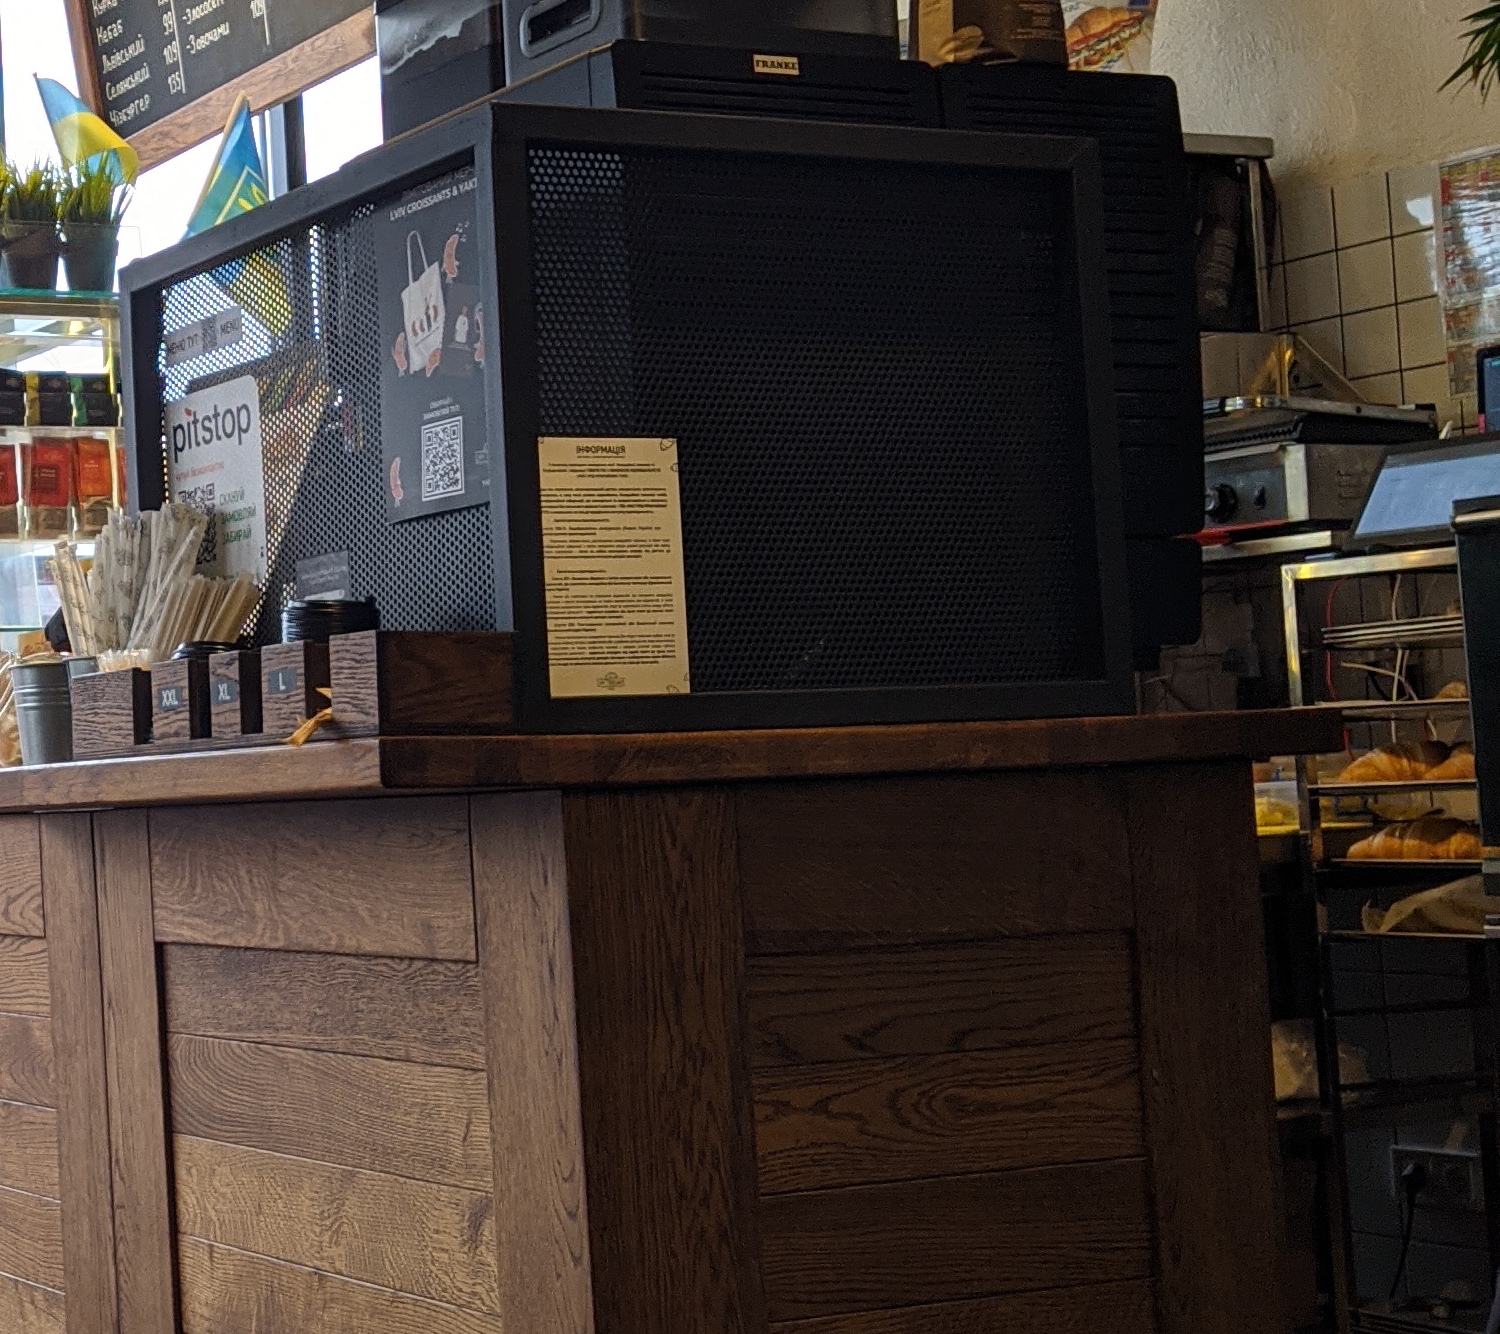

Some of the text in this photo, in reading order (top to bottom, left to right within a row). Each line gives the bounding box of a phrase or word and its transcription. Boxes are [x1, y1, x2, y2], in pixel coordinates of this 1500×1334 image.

[755, 59, 798, 70] FRANKE
[172, 401, 251, 464] pitstop
[278, 672, 286, 691] L
[161, 689, 179, 707] XXL
[218, 683, 231, 701] XL
